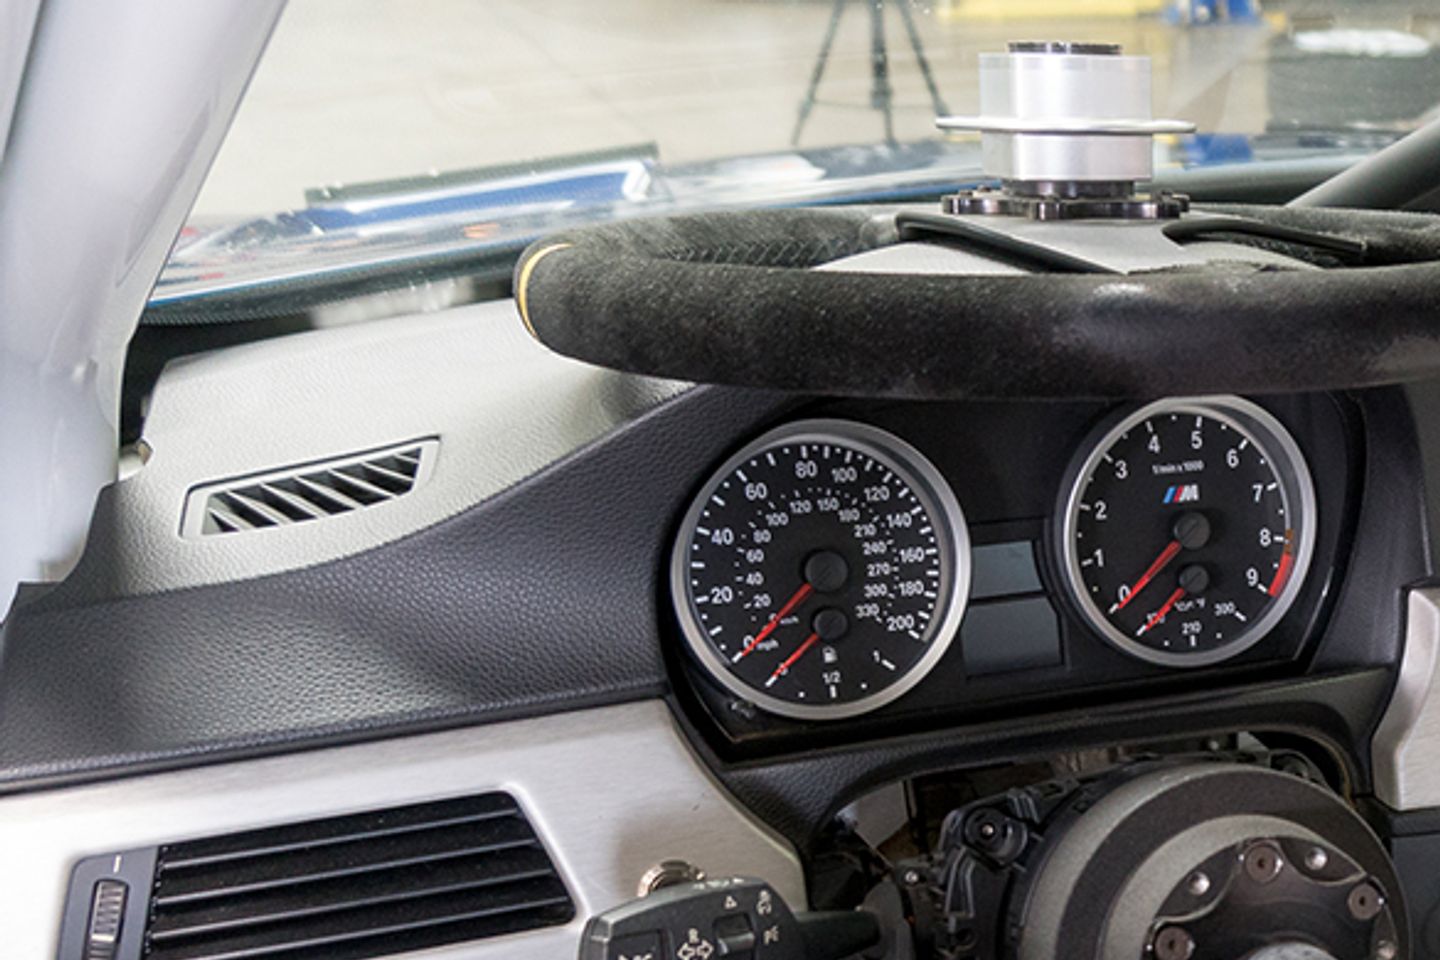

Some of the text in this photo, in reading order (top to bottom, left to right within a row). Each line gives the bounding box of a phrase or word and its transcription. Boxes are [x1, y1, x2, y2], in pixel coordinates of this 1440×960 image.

[1148, 435, 1160, 453] 4
[1191, 431, 1203, 449] 5
[1226, 449, 1239, 469] 6
[795, 461, 817, 478] 80
[832, 467, 857, 482] 100
[1115, 461, 1128, 479] 3
[745, 483, 767, 499] 60
[864, 486, 889, 501] 120
[1253, 484, 1264, 502] 7
[790, 500, 812, 513] 120
[1095, 502, 1107, 520] 2
[765, 512, 789, 526] 100
[886, 512, 912, 528] 140
[711, 528, 734, 545] 40
[854, 523, 877, 538] 210
[1259, 528, 1271, 547] 8
[746, 549, 764, 563] 60
[900, 546, 925, 563] 160
[1094, 549, 1104, 567] 1
[866, 562, 890, 577] 270
[1246, 567, 1259, 586] 9
[746, 572, 764, 585] 40
[711, 587, 733, 603] 20
[864, 583, 888, 598] 300
[899, 580, 924, 596] 180
[753, 594, 771, 608] 20
[855, 603, 880, 618] 330
[886, 613, 915, 632] 200
[822, 671, 841, 684] 1/2
